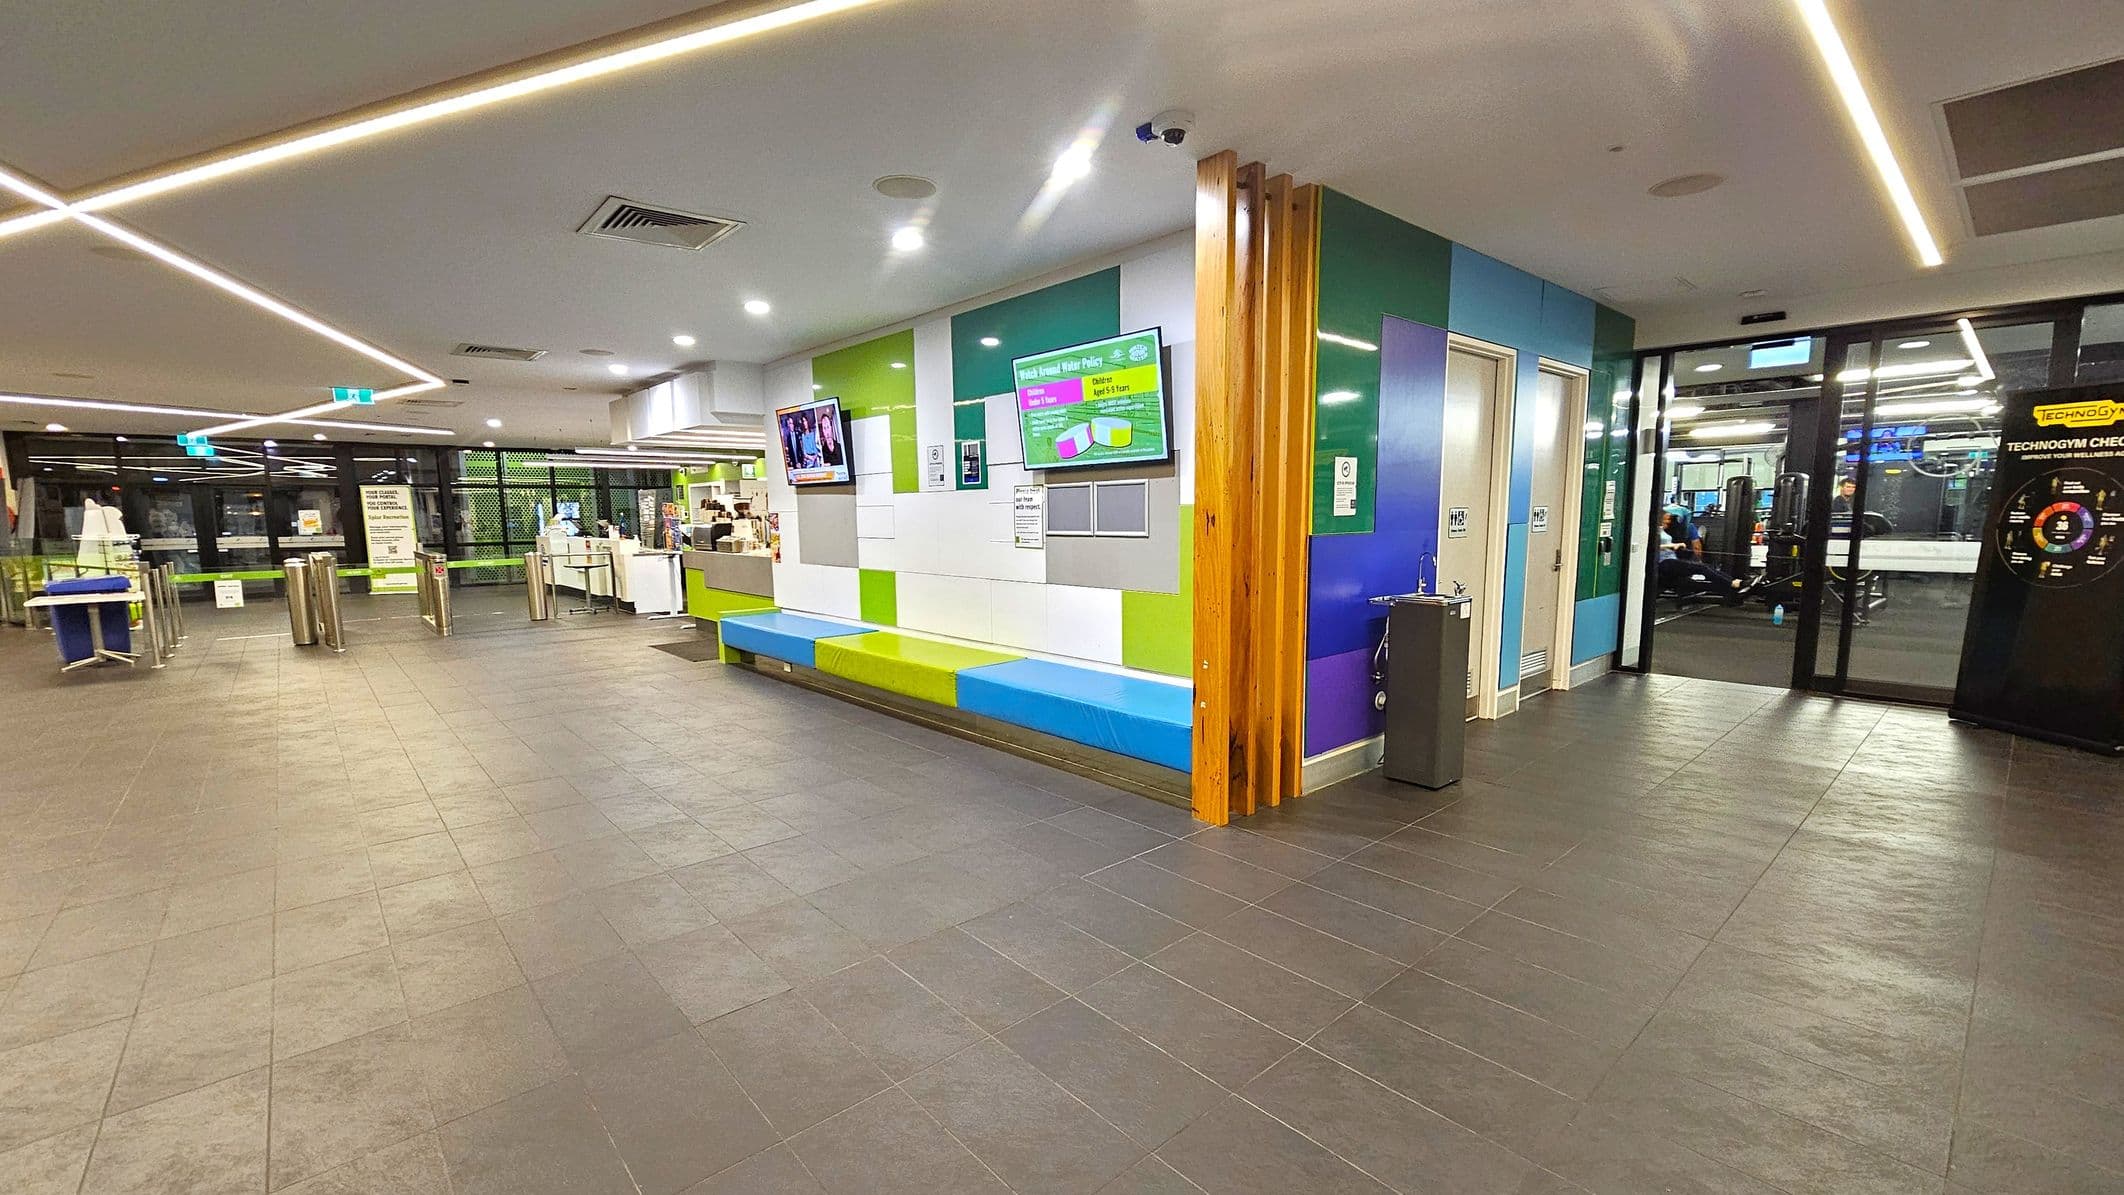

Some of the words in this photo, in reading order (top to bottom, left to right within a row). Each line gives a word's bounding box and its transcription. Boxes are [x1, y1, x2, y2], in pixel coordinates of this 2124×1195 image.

[1019, 367, 1038, 380] Watch
[1038, 363, 1060, 377] Around
[1061, 360, 1080, 373] Water
[1082, 356, 1103, 369] Policy
[1092, 376, 1112, 386] Children
[1093, 388, 1105, 398] Aged
[1115, 384, 1130, 393] Years
[2006, 438, 2087, 452] TECHNOGYM
